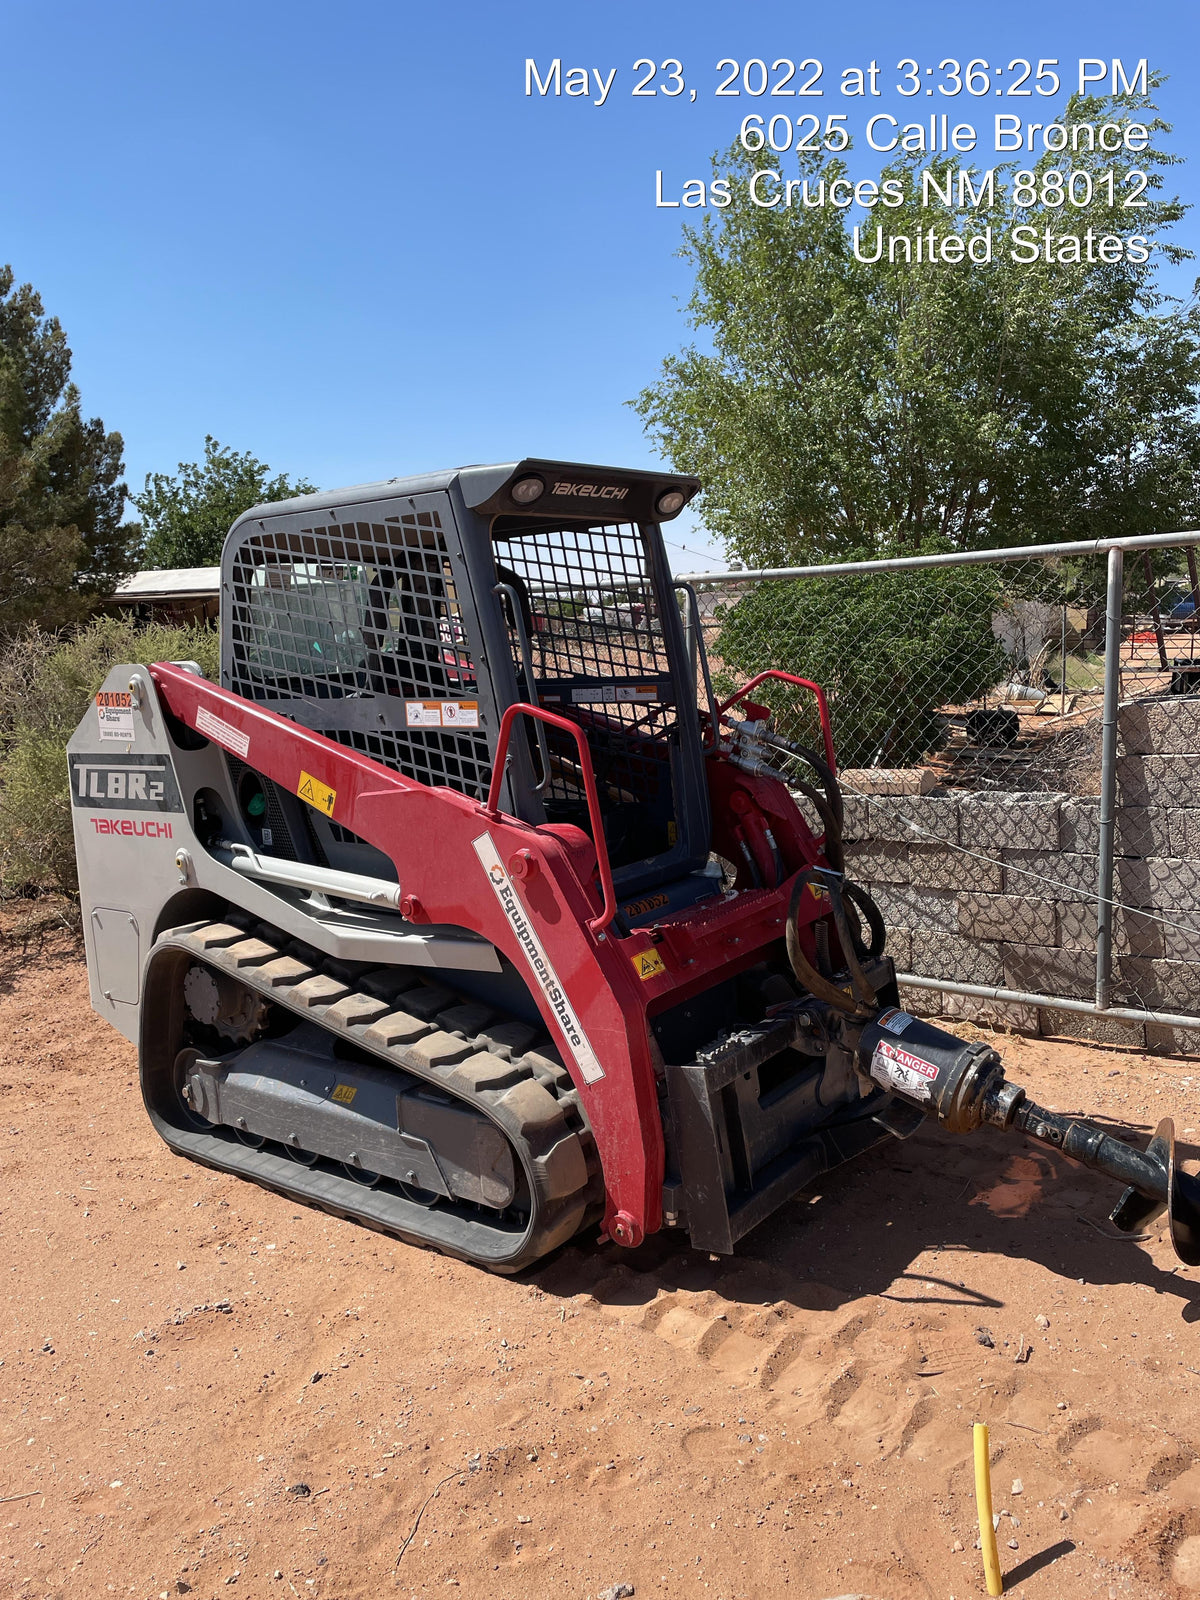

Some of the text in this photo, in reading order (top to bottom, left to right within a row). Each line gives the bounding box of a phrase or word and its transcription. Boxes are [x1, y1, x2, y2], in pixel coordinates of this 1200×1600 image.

[98, 692, 132, 707] 201052
[623, 894, 669, 917] 201052
[499, 885, 582, 1048] EquipmentShare
